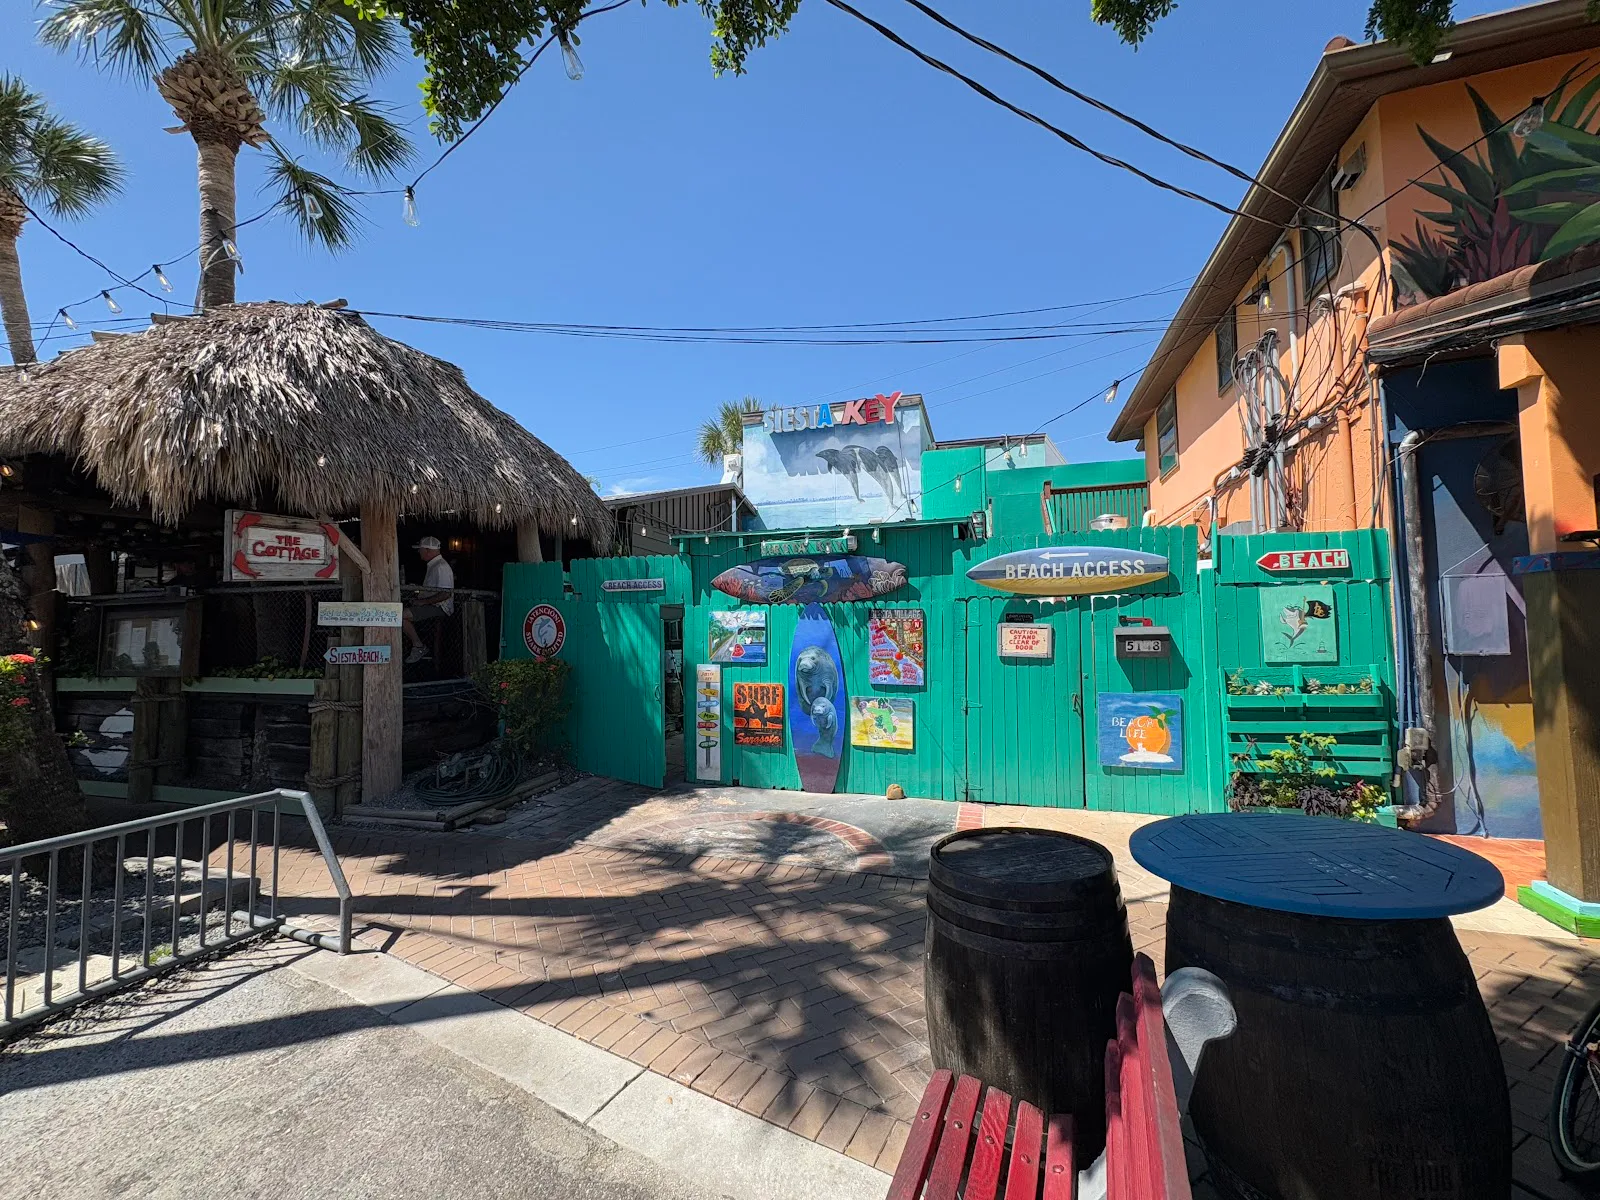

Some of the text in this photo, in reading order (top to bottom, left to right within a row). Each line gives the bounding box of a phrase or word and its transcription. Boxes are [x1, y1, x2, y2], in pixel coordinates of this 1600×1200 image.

[763, 391, 903, 434] SIESTA KEY
[275, 534, 301, 547] THE
[252, 539, 320, 562] COTTAGE
[1279, 551, 1346, 568] BEACH
[1005, 559, 1146, 580] BEACH ACCESS
[608, 580, 662, 590] BEACH ACCESS
[894, 609, 920, 619] VILLAGE
[525, 631, 542, 655] SHARK
[1127, 641, 1160, 651] 518
[329, 647, 357, 663] SIESTA
[357, 648, 380, 663] BEACH
[737, 685, 780, 705] SURF
[736, 732, 781, 744] Sarasota
[1119, 728, 1147, 739] LIFE
